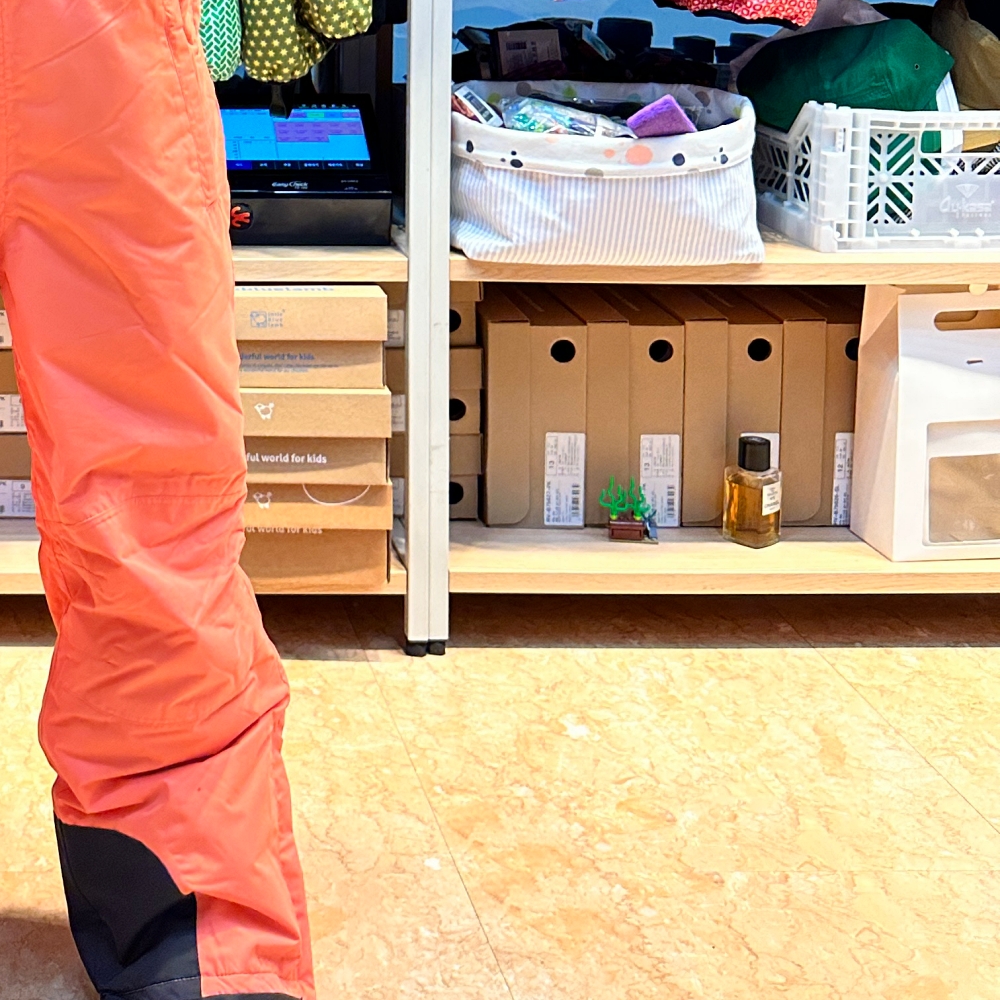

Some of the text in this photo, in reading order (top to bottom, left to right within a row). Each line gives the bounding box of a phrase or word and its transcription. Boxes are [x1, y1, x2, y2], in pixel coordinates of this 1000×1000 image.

[261, 453, 290, 463] world
[291, 453, 306, 463] for
[307, 453, 328, 464] kids
